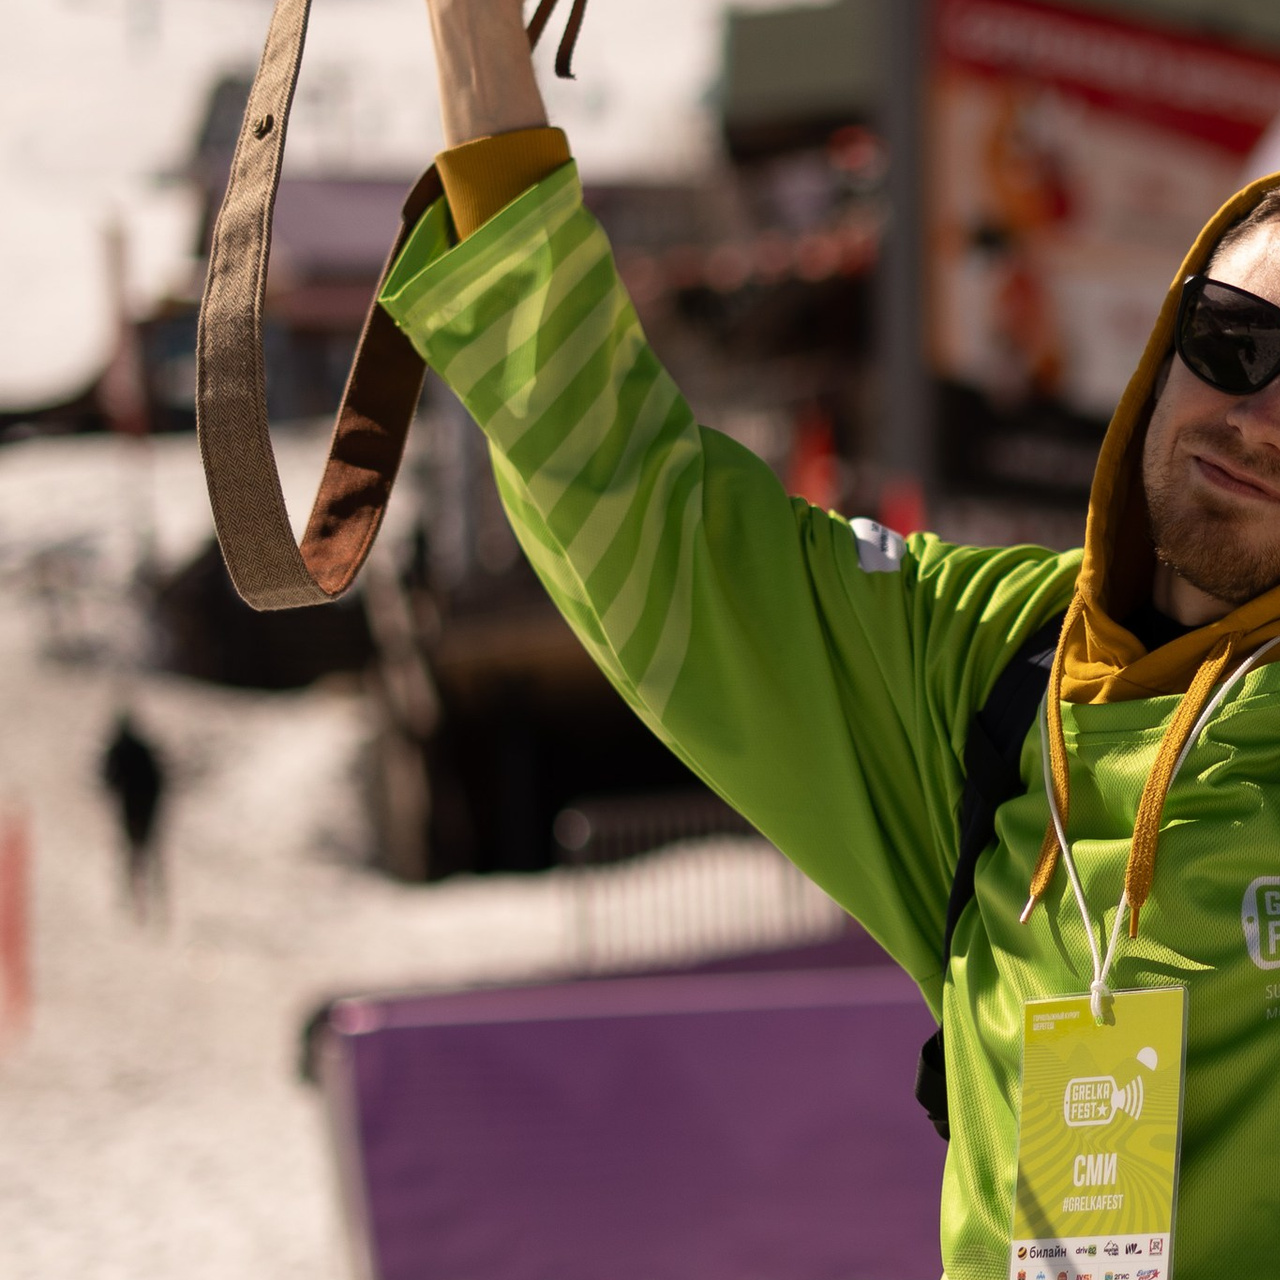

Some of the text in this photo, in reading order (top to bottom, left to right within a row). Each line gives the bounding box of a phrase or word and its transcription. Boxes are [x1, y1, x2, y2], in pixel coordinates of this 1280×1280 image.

[1072, 1083, 1110, 1101] GRELKA
[1071, 1103, 1098, 1120] FEST
[1073, 1152, 1118, 1187] СМИ
[1062, 1194, 1124, 1213] #GRELKAFEST
[1029, 1245, 1067, 1259] билайн
